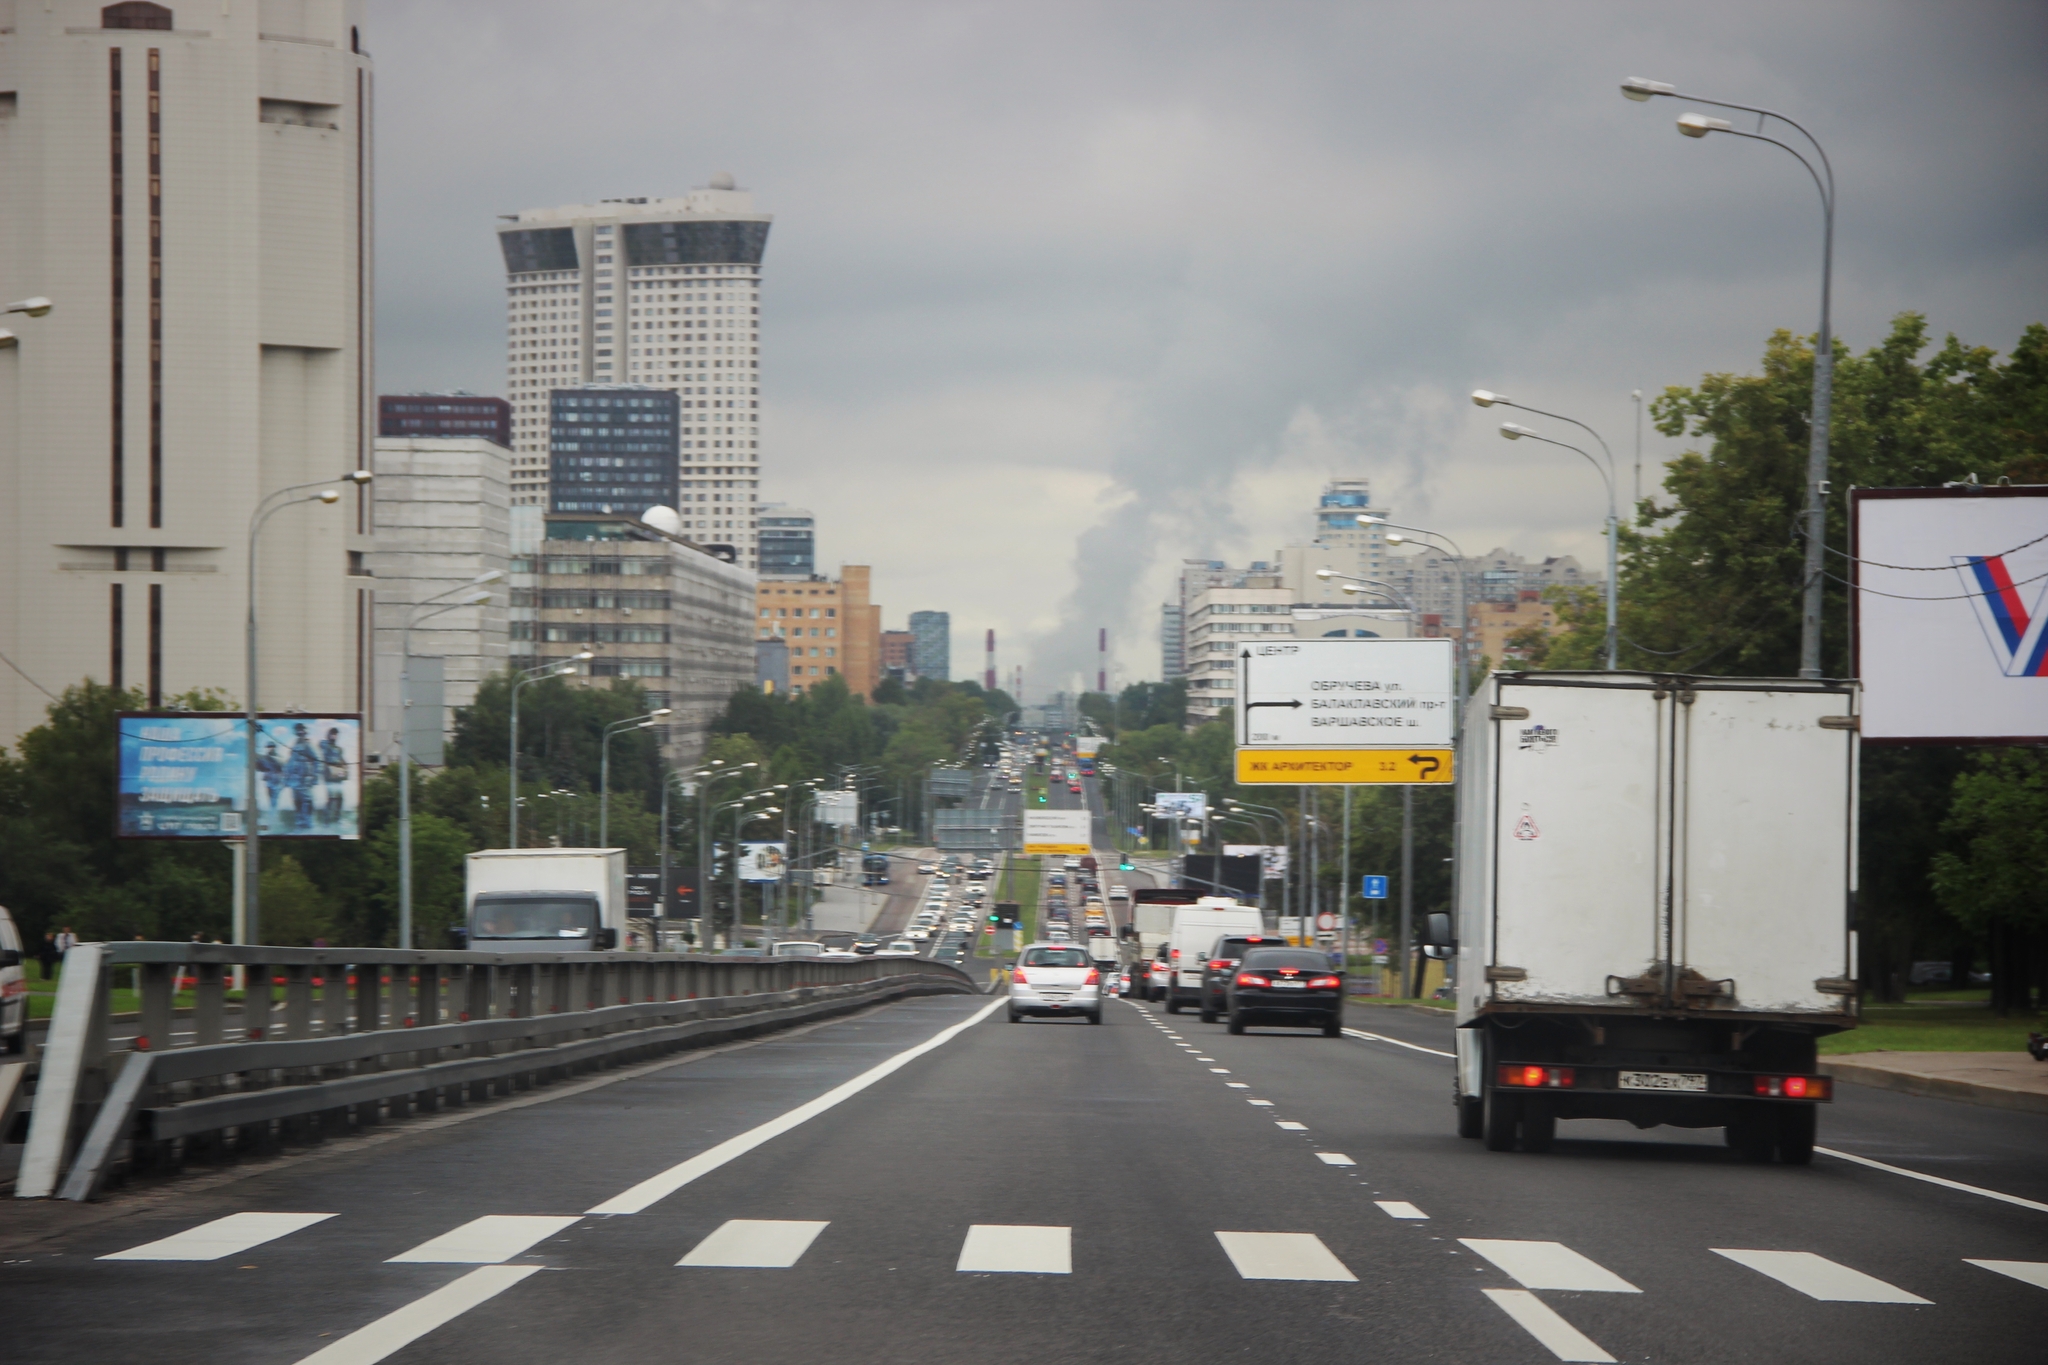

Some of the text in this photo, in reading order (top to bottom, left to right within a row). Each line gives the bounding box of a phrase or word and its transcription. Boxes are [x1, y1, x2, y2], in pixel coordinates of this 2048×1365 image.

[1256, 645, 1300, 656] ЦЕНТР
[1311, 680, 1380, 691] ОБРУЧЕВА
[1310, 697, 1416, 709] БАЛАКЛАВСКИЙ
[1310, 716, 1402, 727] ВАРШАВСКОЕ
[1271, 761, 1353, 772] АРХИТЕКТОР
